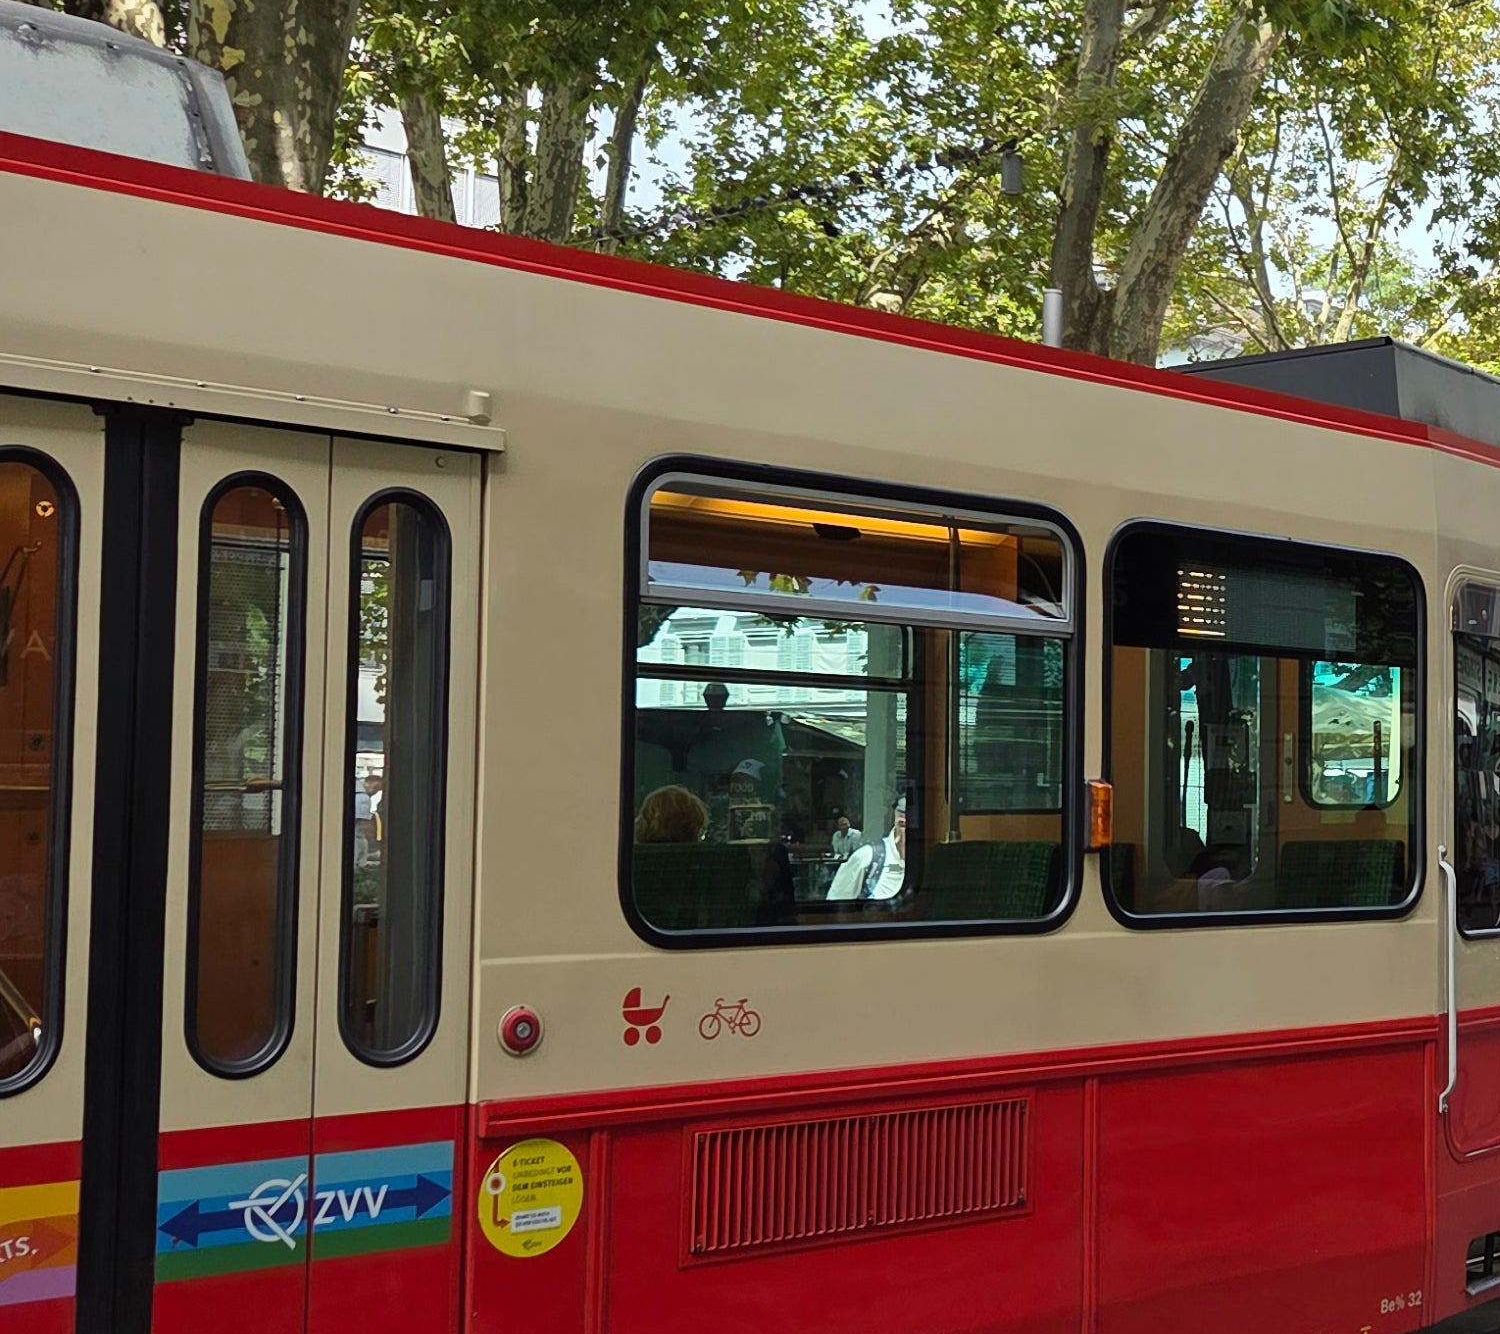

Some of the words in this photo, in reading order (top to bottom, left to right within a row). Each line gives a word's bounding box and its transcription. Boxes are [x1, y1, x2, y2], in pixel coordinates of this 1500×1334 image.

[557, 1165, 572, 1174] VOR
[314, 1184, 389, 1225] ZVV
[1408, 1290, 1422, 1307] 32
